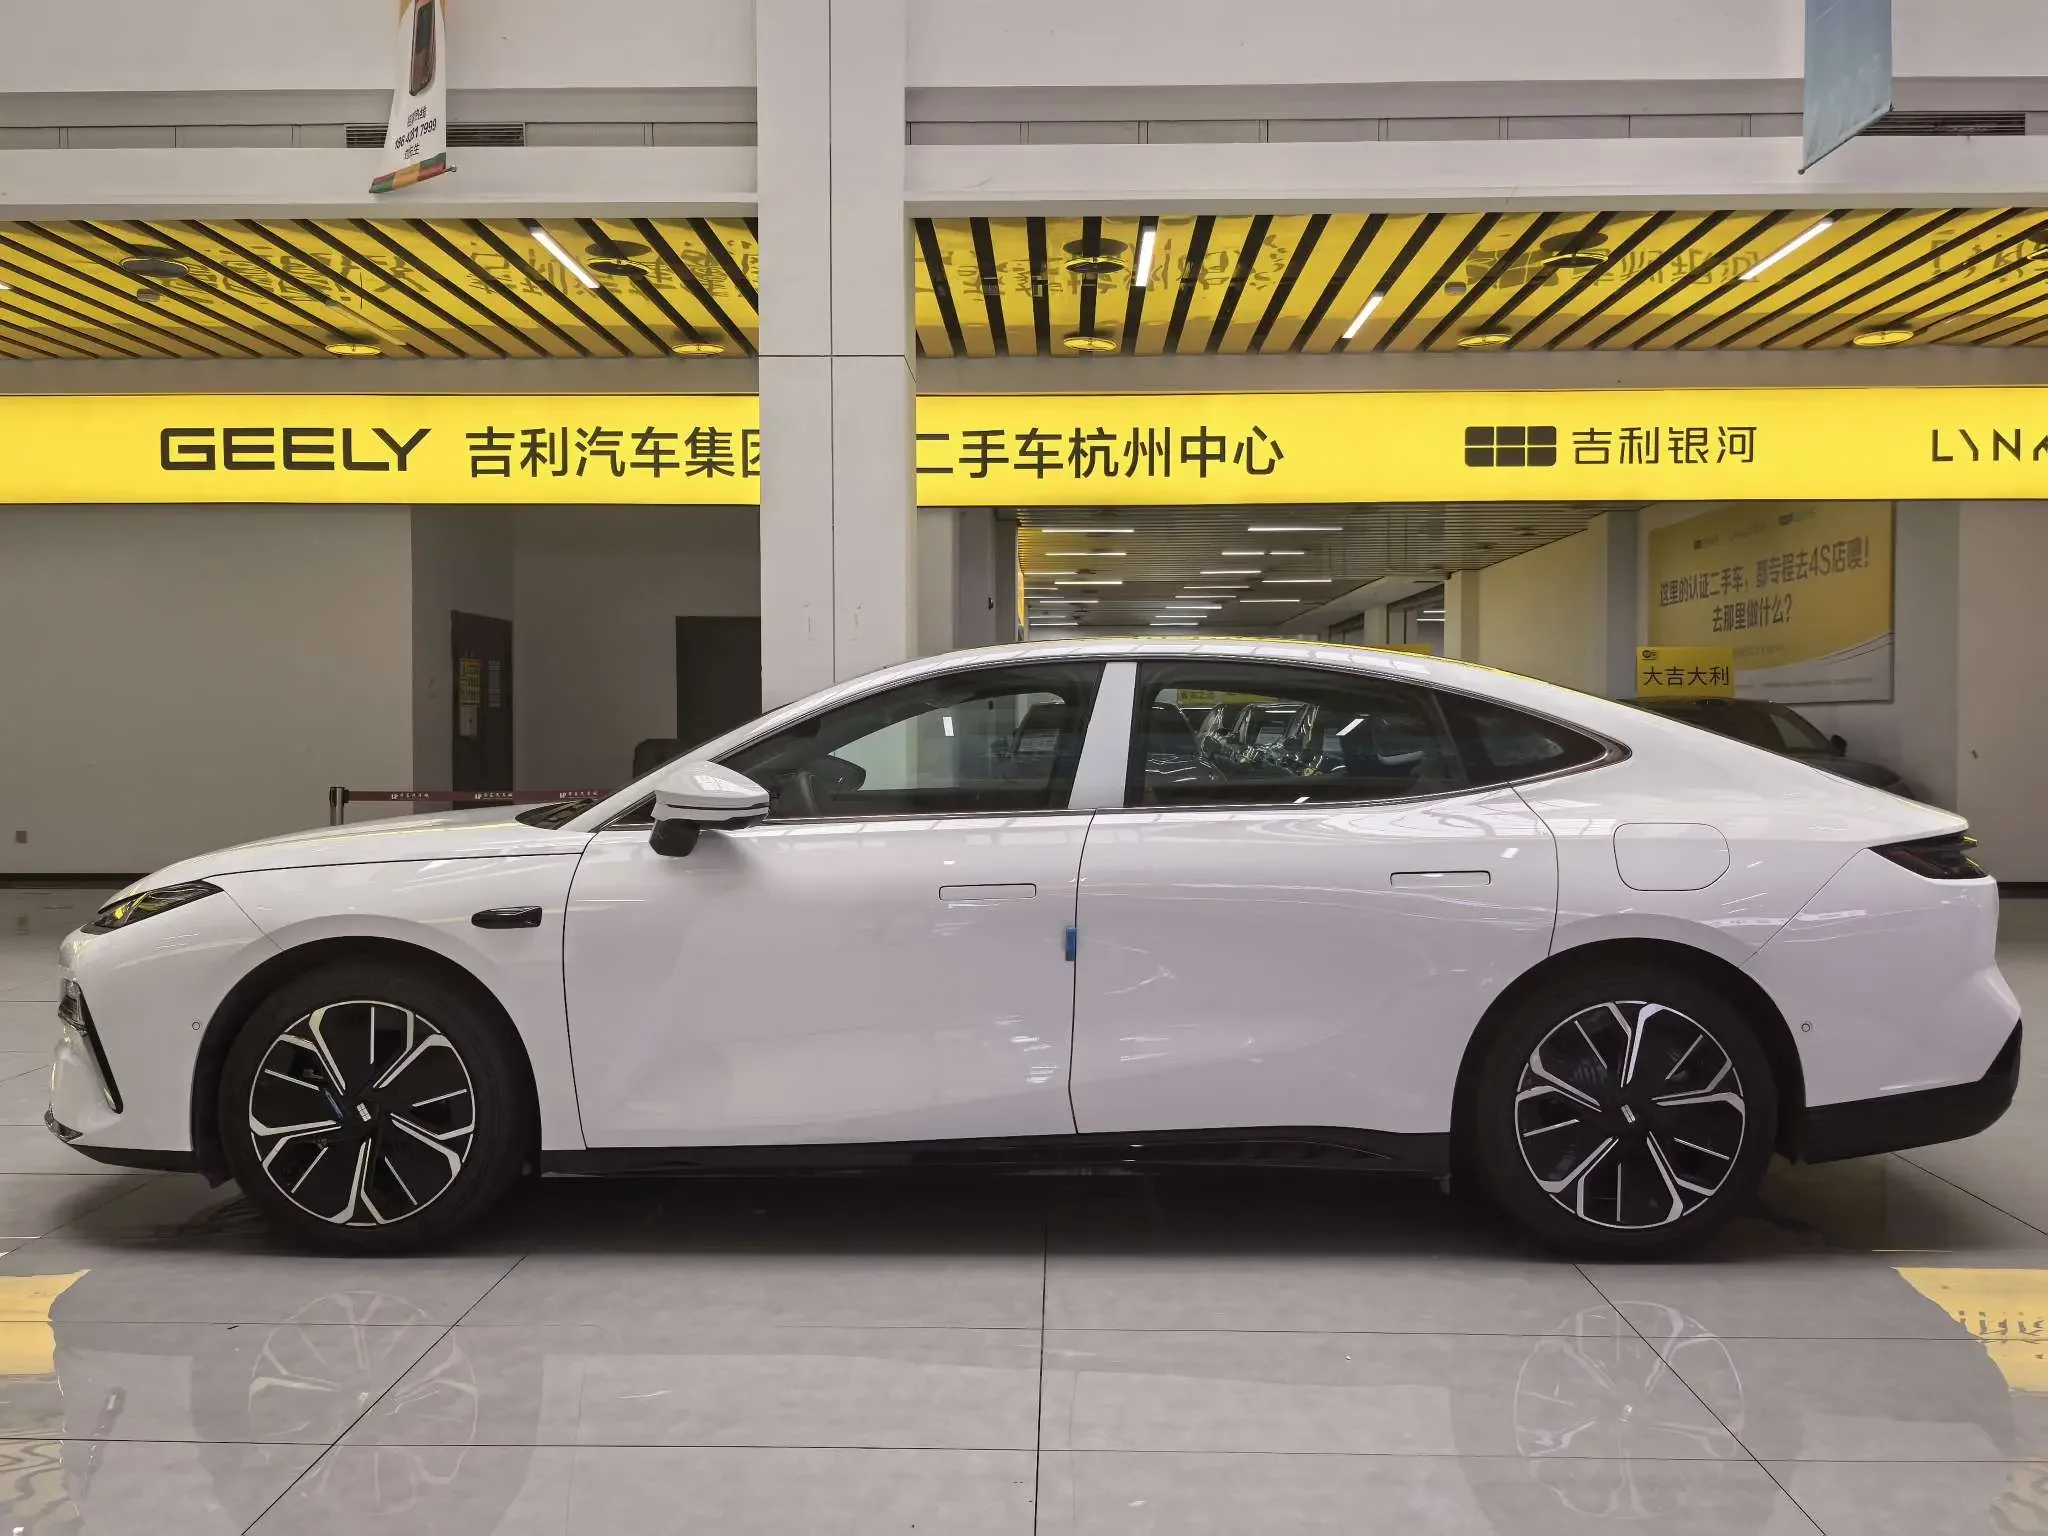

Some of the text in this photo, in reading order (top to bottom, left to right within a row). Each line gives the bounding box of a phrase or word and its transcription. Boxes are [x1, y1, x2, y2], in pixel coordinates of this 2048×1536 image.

[161, 428, 431, 471] GEELY
[917, 426, 1284, 479] 二手车杭州中心
[1573, 427, 1757, 464] 吉利银河
[1643, 665, 1730, 687] 大吉大利
